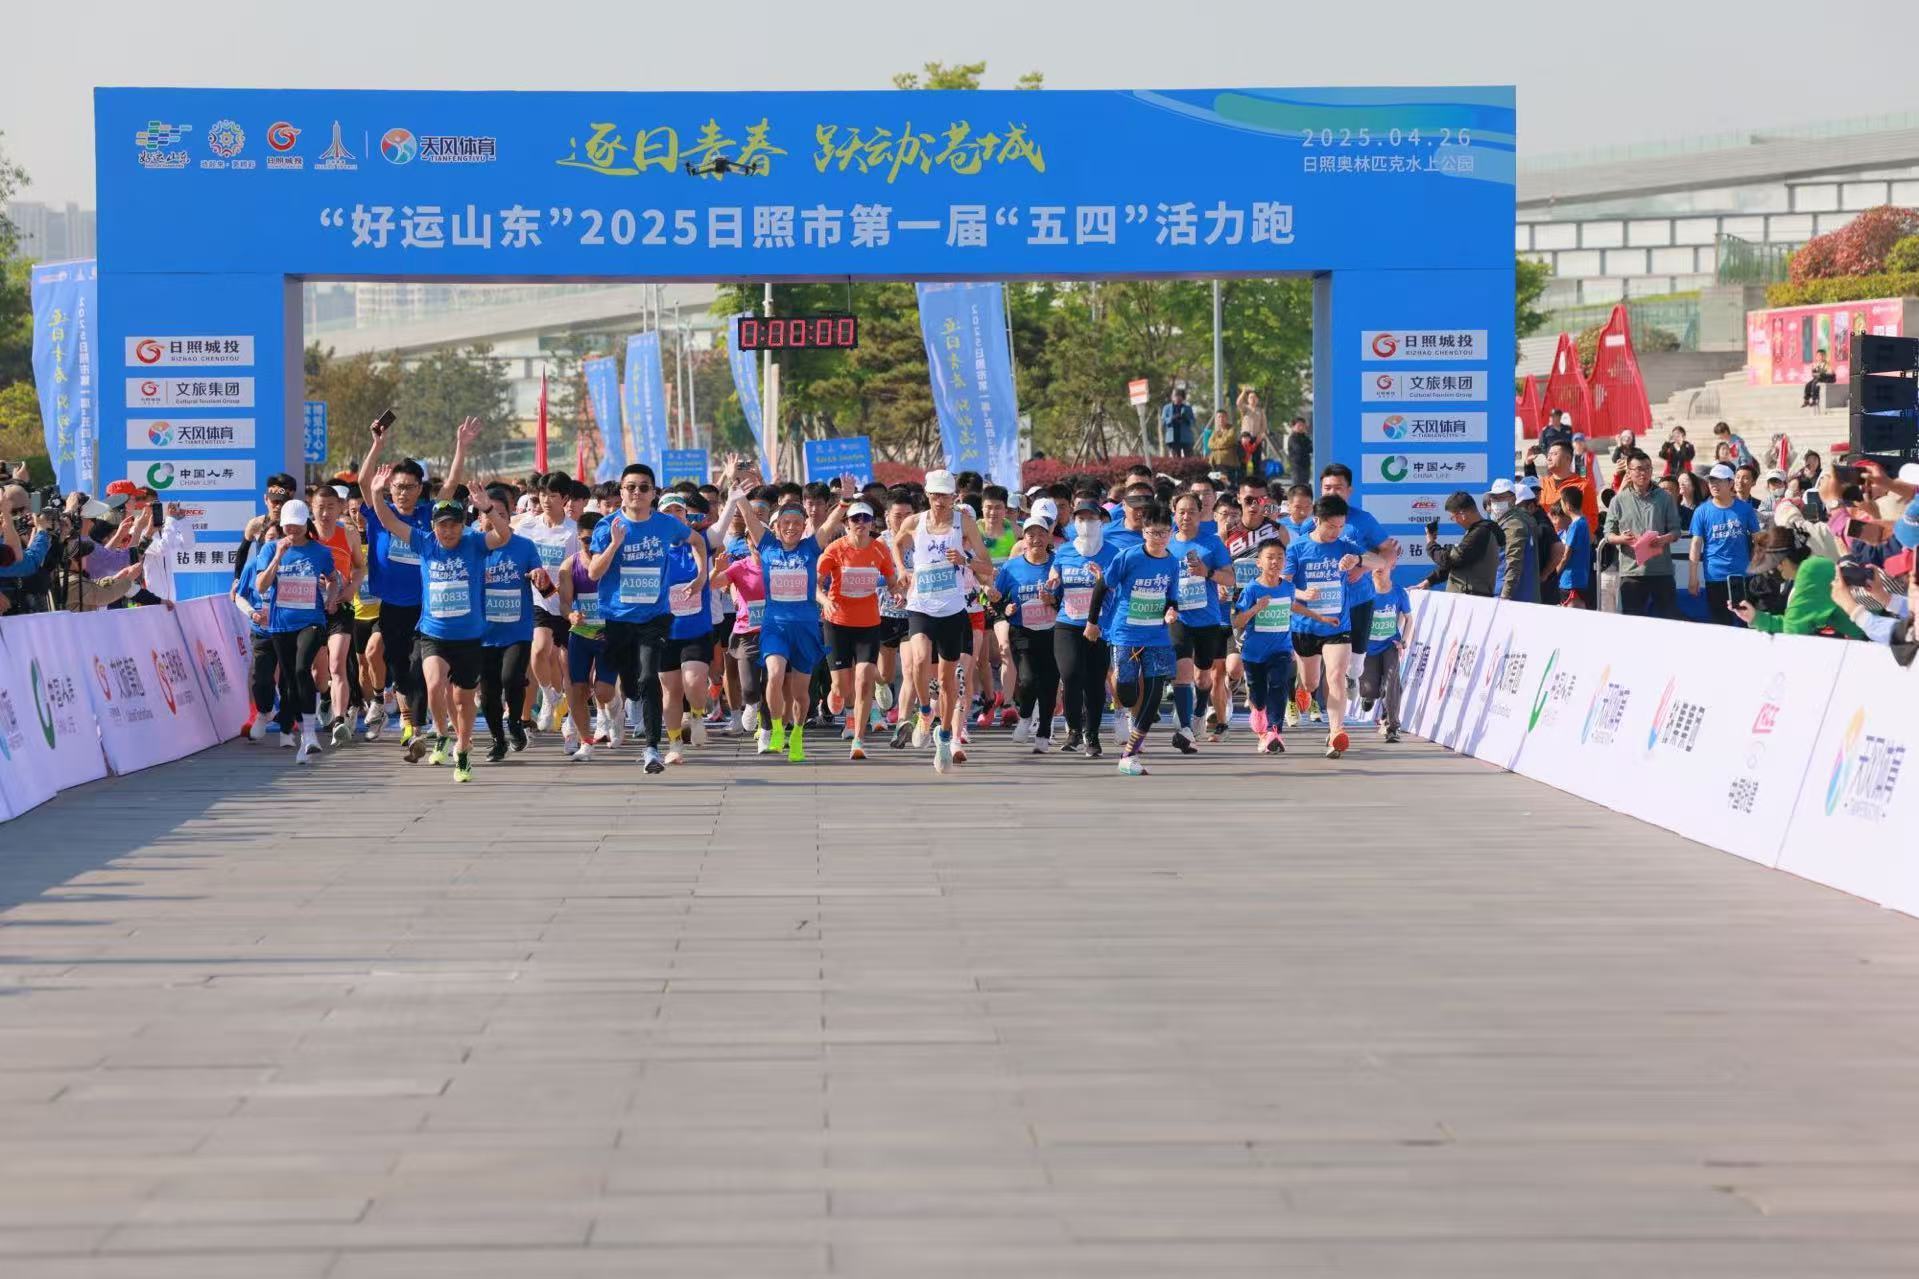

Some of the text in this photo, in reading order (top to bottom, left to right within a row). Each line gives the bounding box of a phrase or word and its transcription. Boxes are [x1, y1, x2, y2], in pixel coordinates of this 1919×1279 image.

[1302, 127, 1473, 147] 2025.04.26
[421, 137, 496, 156] 天风体育
[556, 119, 1046, 184] 逐日青春 跃动港城
[430, 155, 486, 163] TIANFENGTIYU
[1303, 155, 1475, 174] 日照奥林匹克水上公园
[319, 201, 1297, 250] “好运山东”2025日照市第一届“五四”活力跑
[741, 319, 855, 347] 0:00:00
[170, 340, 240, 354] 日照城投
[1405, 335, 1473, 348] 日照城投
[176, 382, 240, 397] 文旅集团
[1410, 376, 1473, 390] 文旅集团
[178, 426, 234, 440] 天风体育
[1411, 420, 1466, 434] 天风体育
[180, 468, 234, 480] 中国人寿
[1413, 462, 1467, 473] 中国人寿
[918, 570, 954, 584] A10357
[1236, 567, 1262, 576] A100
[622, 577, 660, 588] A10860
[431, 591, 468, 603] A10835
[1320, 591, 1341, 600] 0328
[486, 599, 520, 608] A10310
[1371, 620, 1395, 629] 0230
